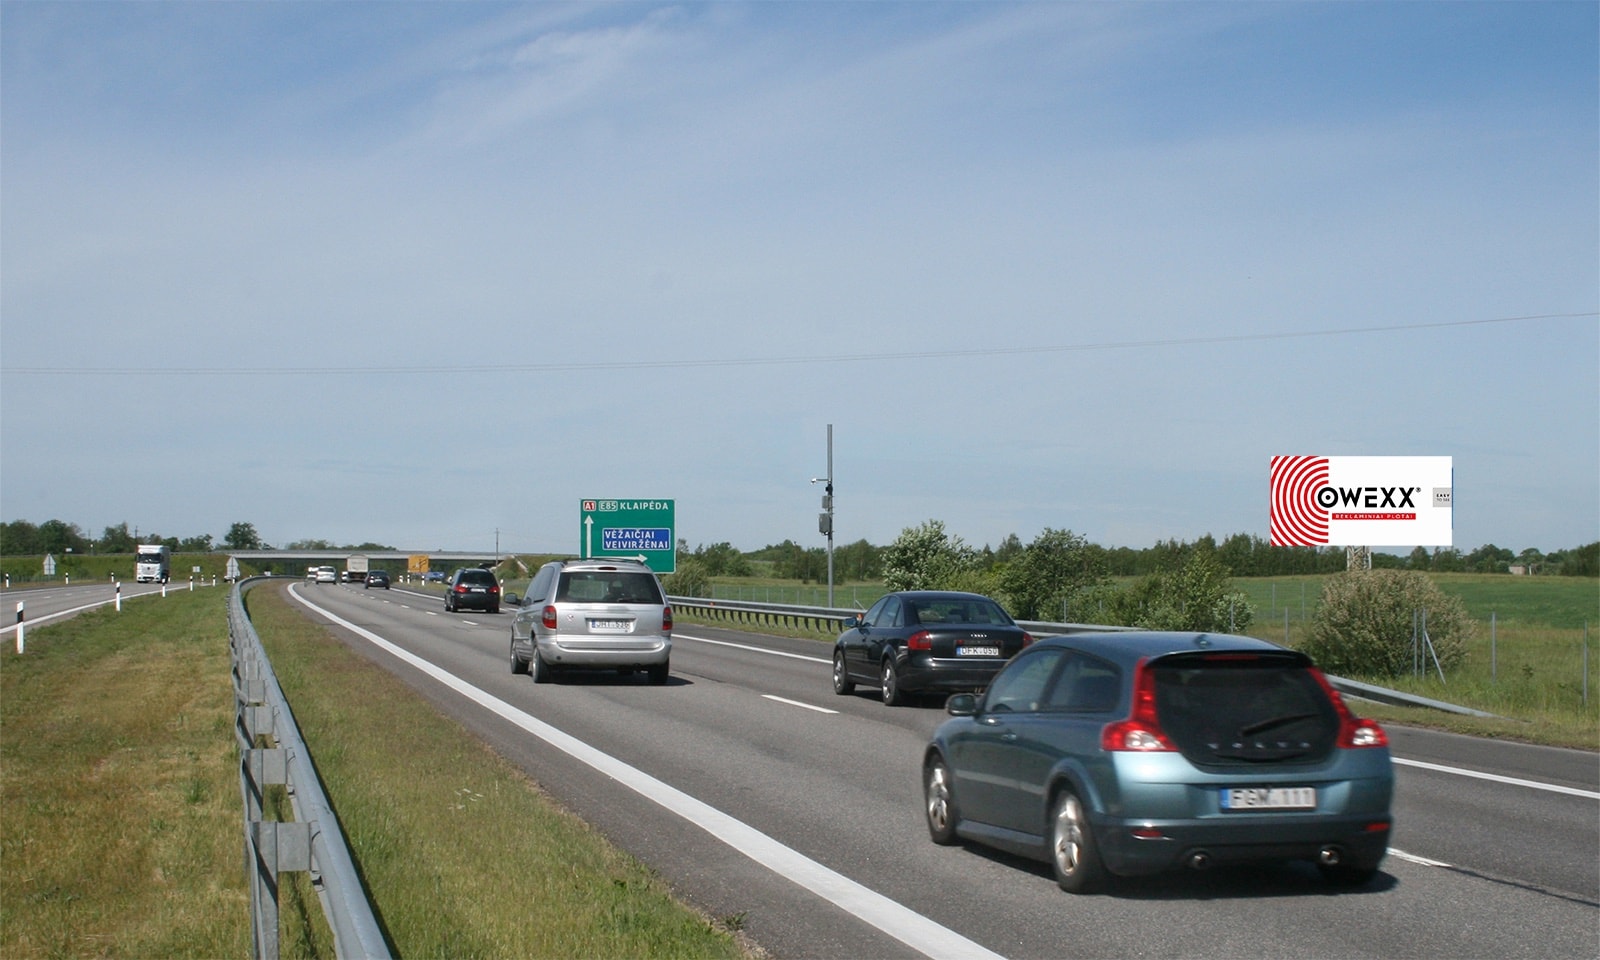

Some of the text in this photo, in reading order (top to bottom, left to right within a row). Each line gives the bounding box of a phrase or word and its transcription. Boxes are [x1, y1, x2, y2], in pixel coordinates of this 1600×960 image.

[584, 500, 669, 510] A1 E85 KLAIPĖDA
